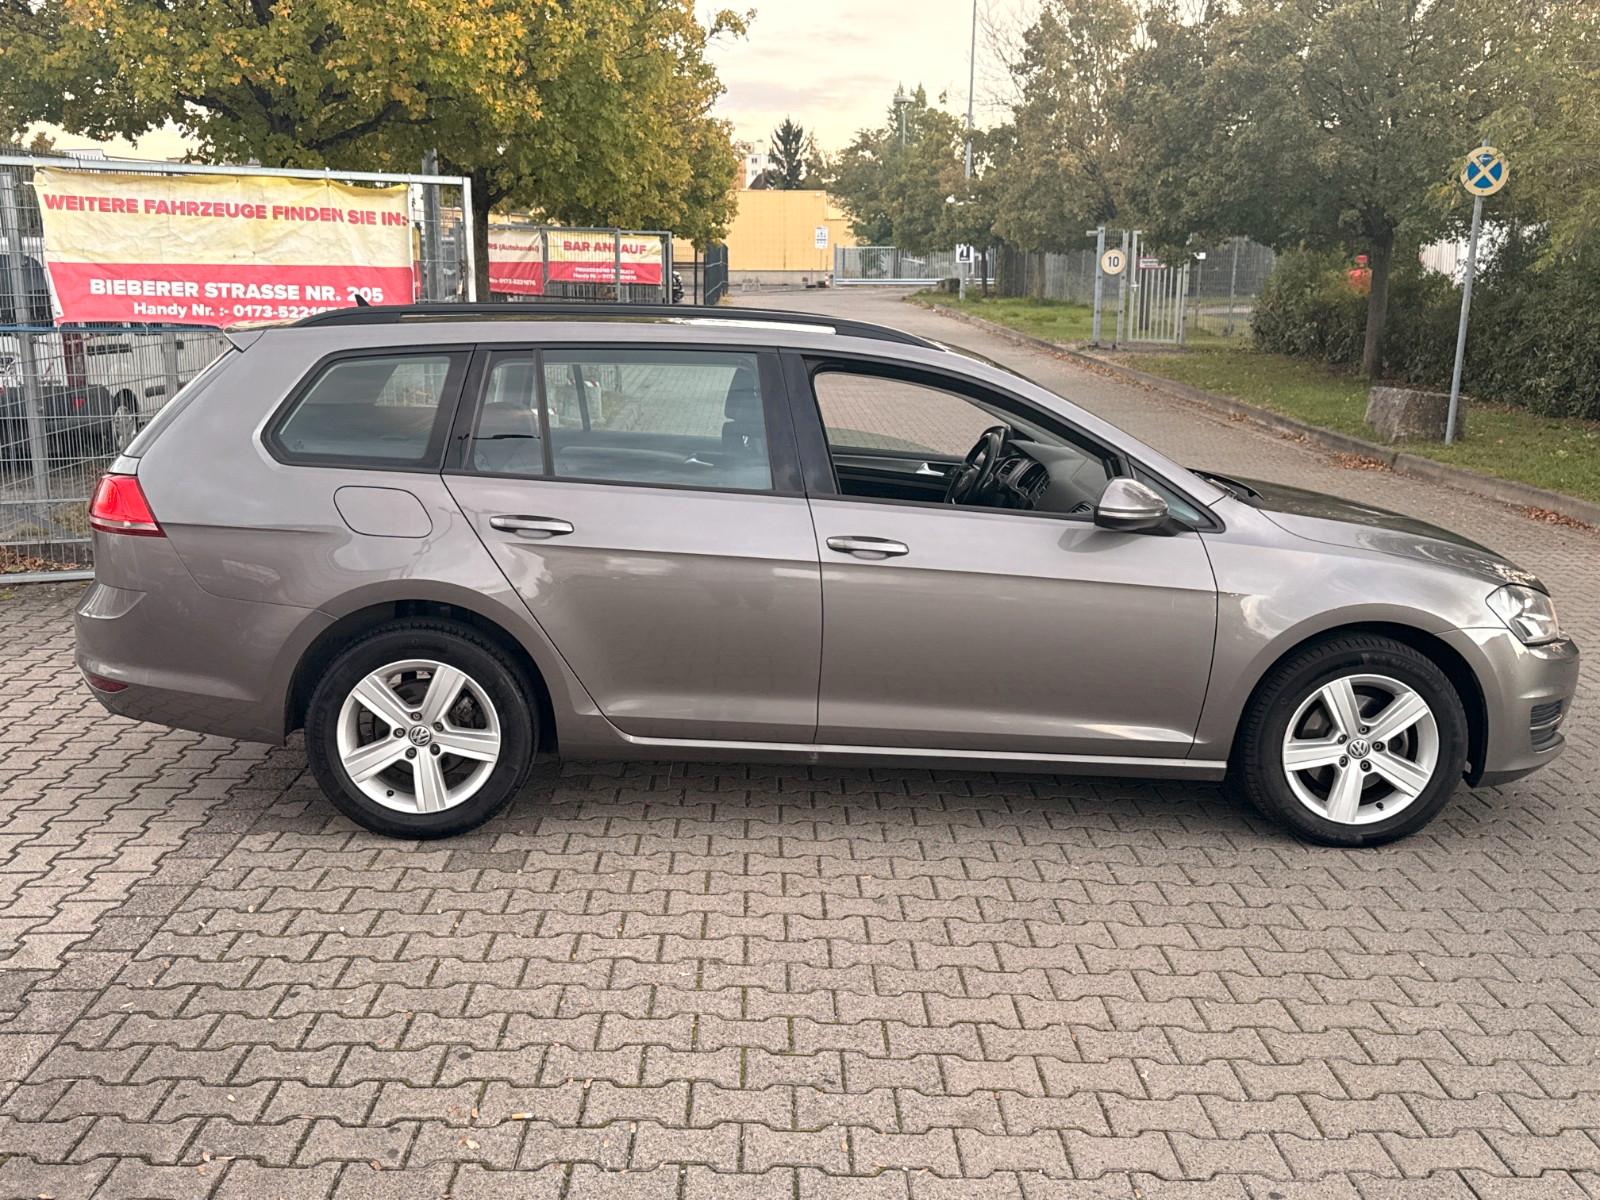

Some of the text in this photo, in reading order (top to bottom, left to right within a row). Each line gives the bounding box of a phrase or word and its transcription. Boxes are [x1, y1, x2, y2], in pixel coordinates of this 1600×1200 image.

[43, 194, 139, 213] WEITERE
[144, 199, 267, 219] FAHRZEUGE
[272, 205, 344, 222] FINDEN
[347, 210, 377, 225] SIE
[563, 241, 591, 251] BAR
[1108, 256, 1120, 267] 10
[90, 279, 384, 303] BIEBERER STRASSE NR. 205
[133, 302, 187, 318] Handy
[191, 304, 215, 316] Nr.
